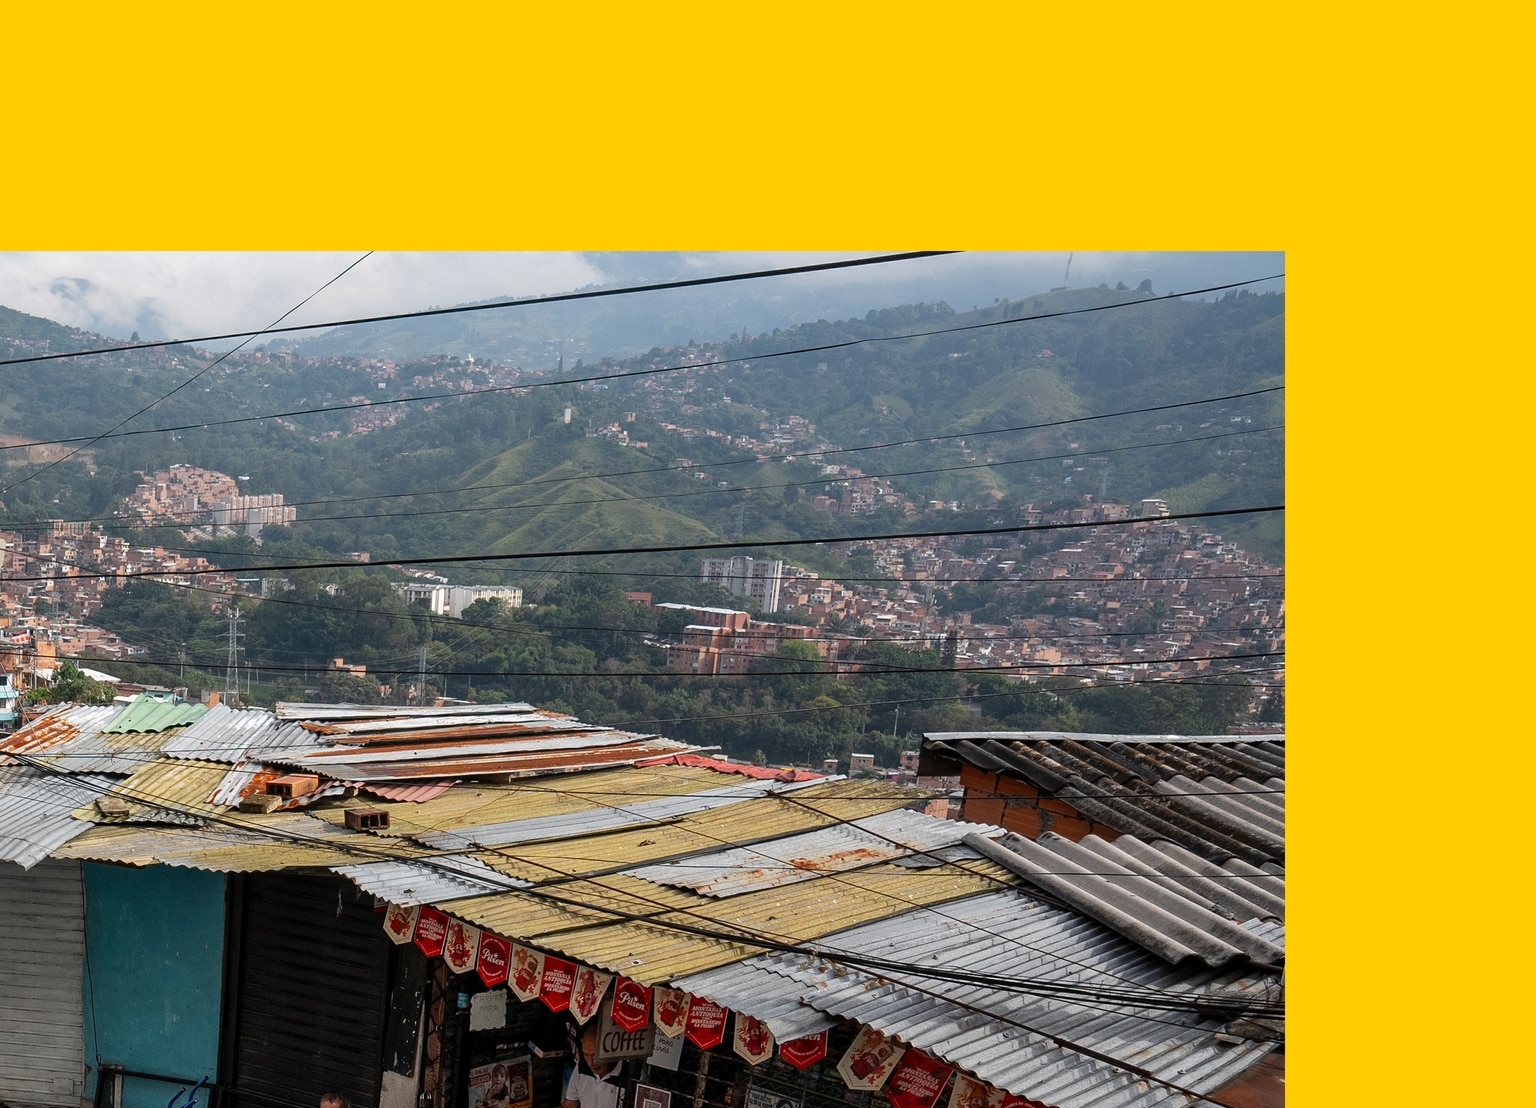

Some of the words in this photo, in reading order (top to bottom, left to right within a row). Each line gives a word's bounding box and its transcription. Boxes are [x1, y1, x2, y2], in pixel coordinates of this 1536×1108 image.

[481, 947, 505, 966] Pilsen
[618, 991, 645, 1011] Pilsen
[603, 1029, 647, 1052] COFFEE
[898, 1072, 939, 1090] ANTIOQUIA
[902, 1066, 940, 1084] MONTAÑAS
